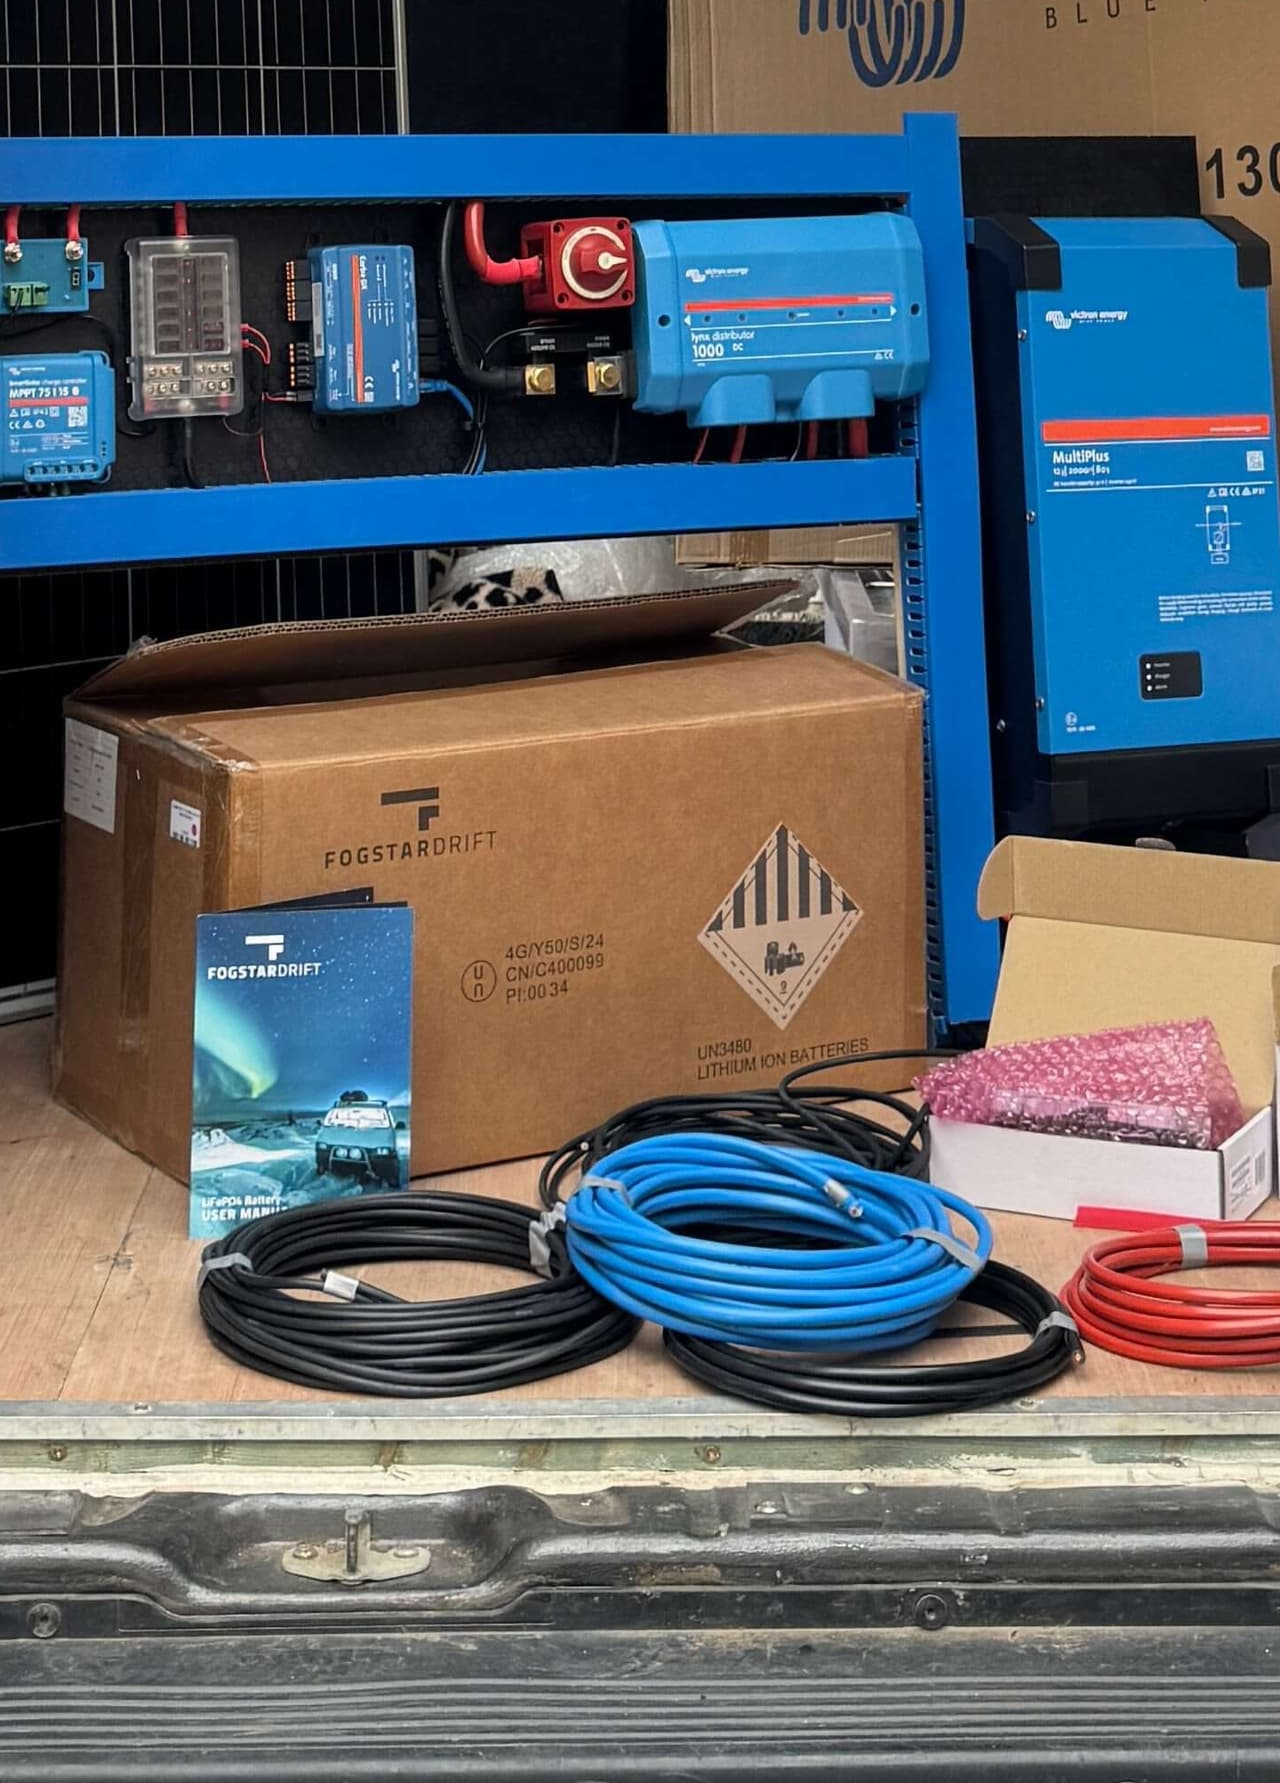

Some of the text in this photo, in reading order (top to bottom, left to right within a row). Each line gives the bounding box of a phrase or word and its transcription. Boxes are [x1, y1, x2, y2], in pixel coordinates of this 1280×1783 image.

[691, 329, 755, 343] lynx distributor
[692, 343, 725, 358] 1000
[9, 387, 36, 399] MPPT
[1052, 448, 1111, 465] MultiPlus
[324, 829, 498, 869] FOGSTARDRIFT
[504, 933, 605, 961] 4G/Y50/S/24
[207, 962, 322, 981] FOGSTARDRIFT
[505, 952, 605, 983] CN/C400099
[696, 1037, 752, 1061] UN3480
[696, 1037, 870, 1081] LITHIUM ION BATTERIES
[244, 1194, 281, 1206] Battery
[201, 1208, 237, 1222] USER
